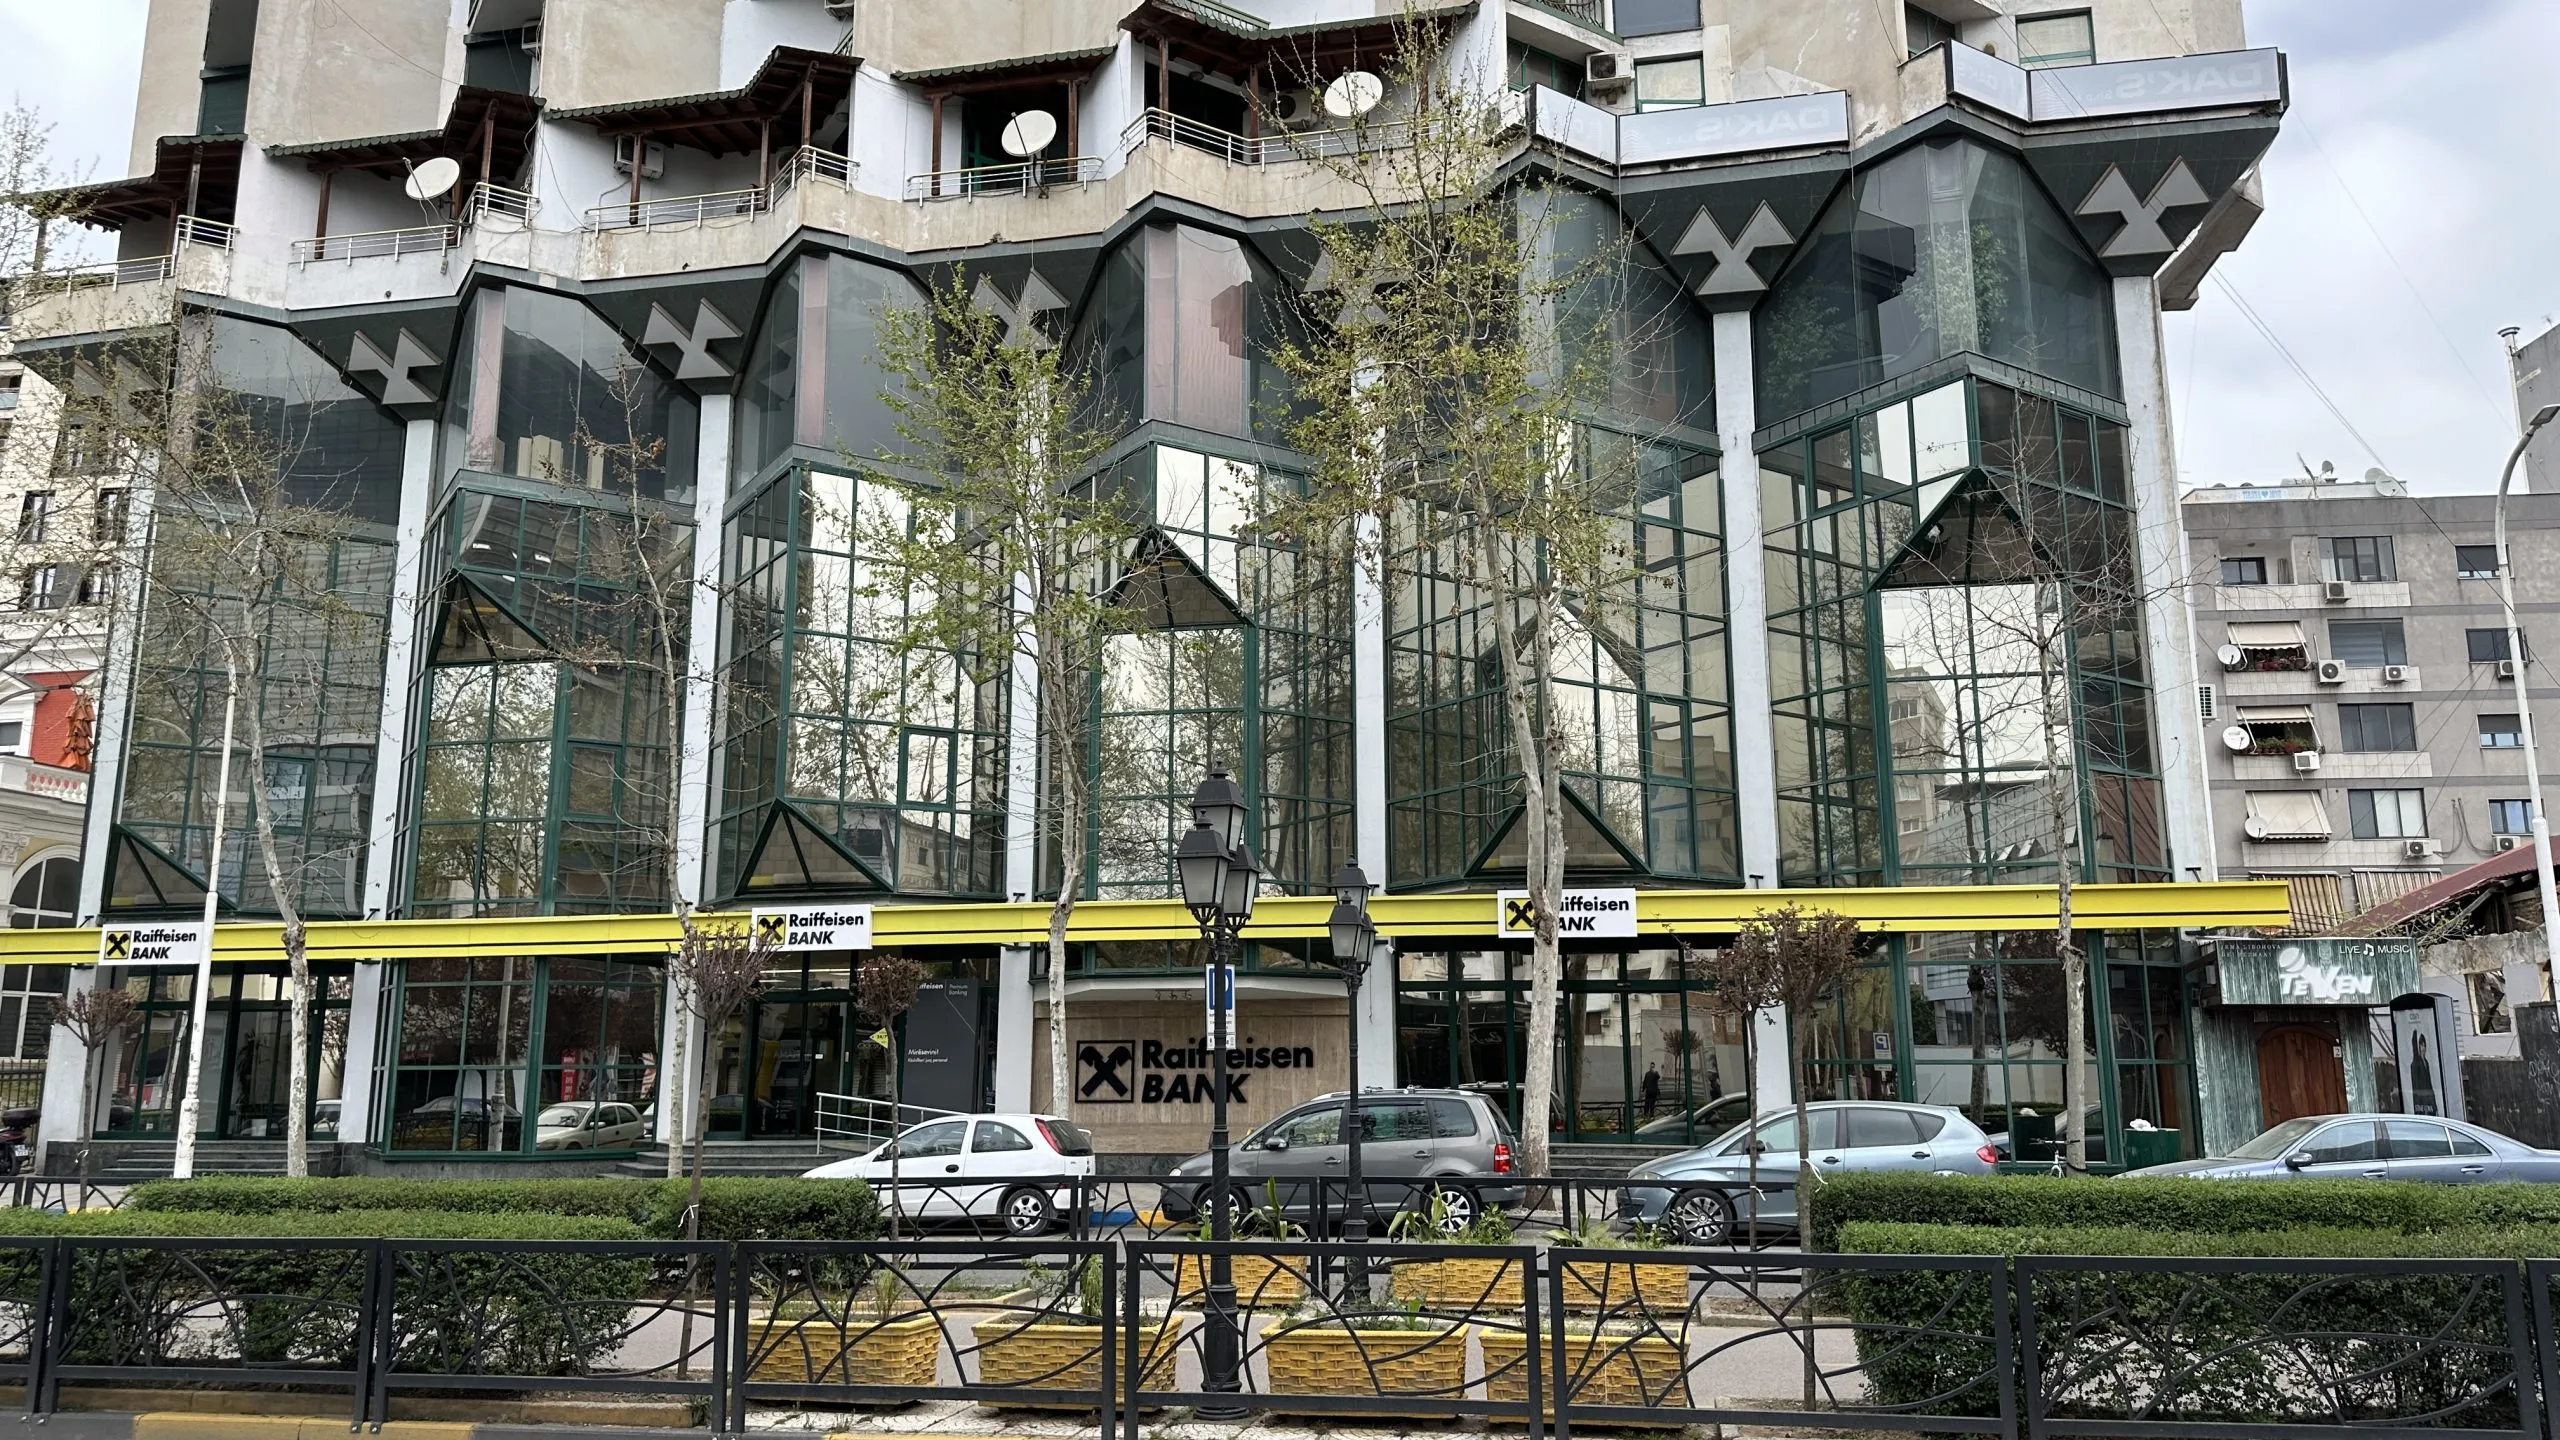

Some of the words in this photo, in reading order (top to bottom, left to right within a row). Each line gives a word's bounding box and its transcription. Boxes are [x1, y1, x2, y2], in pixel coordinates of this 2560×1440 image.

[1559, 896, 1630, 911] iffeisen
[788, 912, 864, 927] Raiffeisen
[1558, 916, 1596, 931] ANK
[133, 929, 197, 943] Raiffeisen
[788, 931, 835, 945] BANK
[131, 946, 172, 960] BANK
[2339, 945, 2361, 954] LIVE
[2377, 944, 2411, 954] MUSIC
[1141, 1037, 1314, 1068] Raifeisen
[1141, 1073, 1250, 1104] BANK
